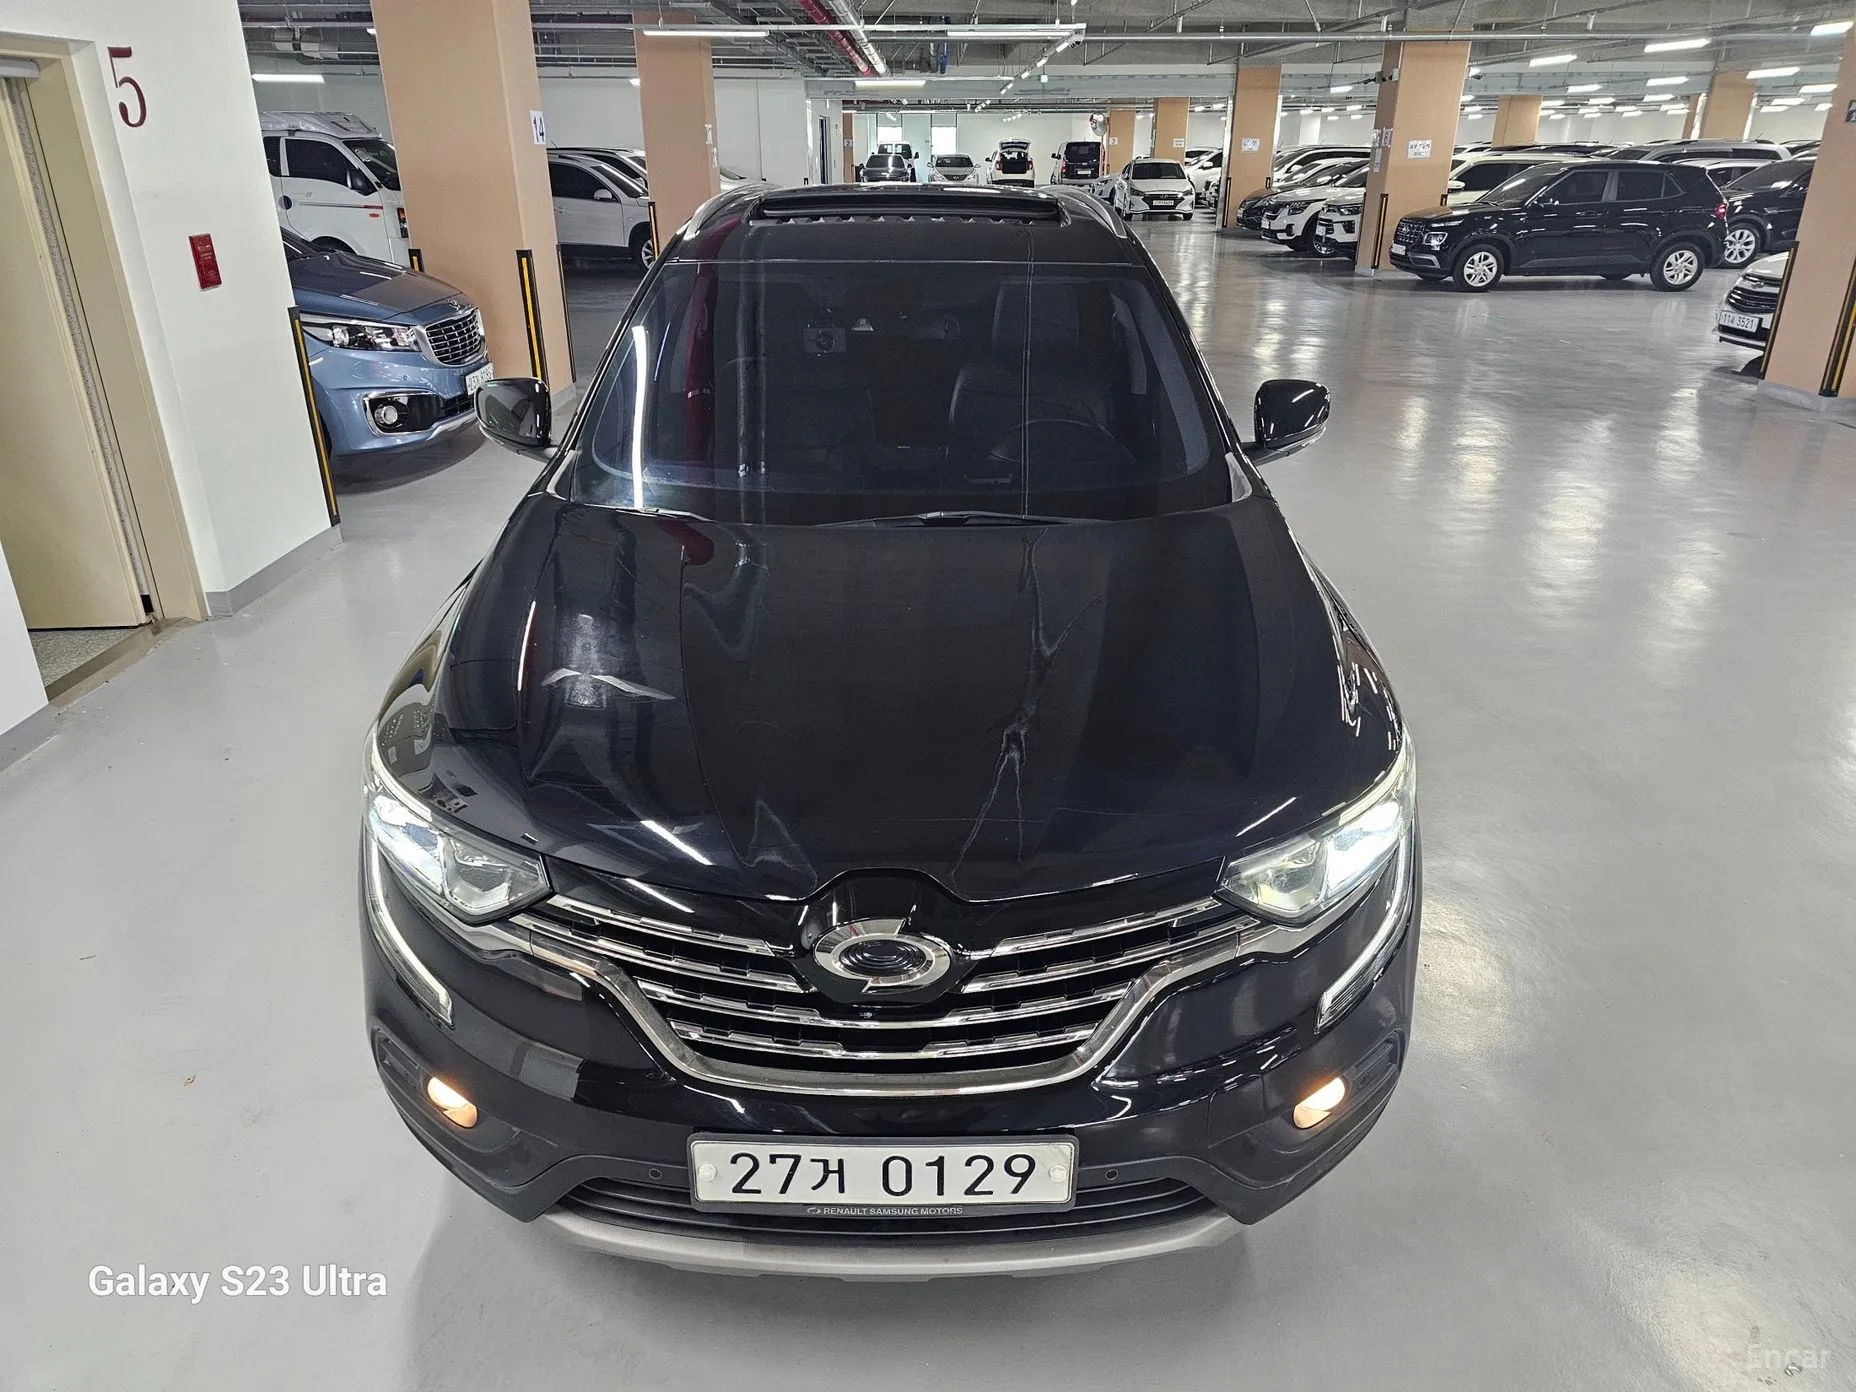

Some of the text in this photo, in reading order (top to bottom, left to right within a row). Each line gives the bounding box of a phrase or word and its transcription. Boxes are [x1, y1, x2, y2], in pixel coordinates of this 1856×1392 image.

[106, 46, 147, 128] 5
[533, 115, 545, 142] 14
[729, 1152, 1036, 1197] 27거 0129
[823, 1207, 963, 1216] RENAULT SAMSUNG MOTORS
